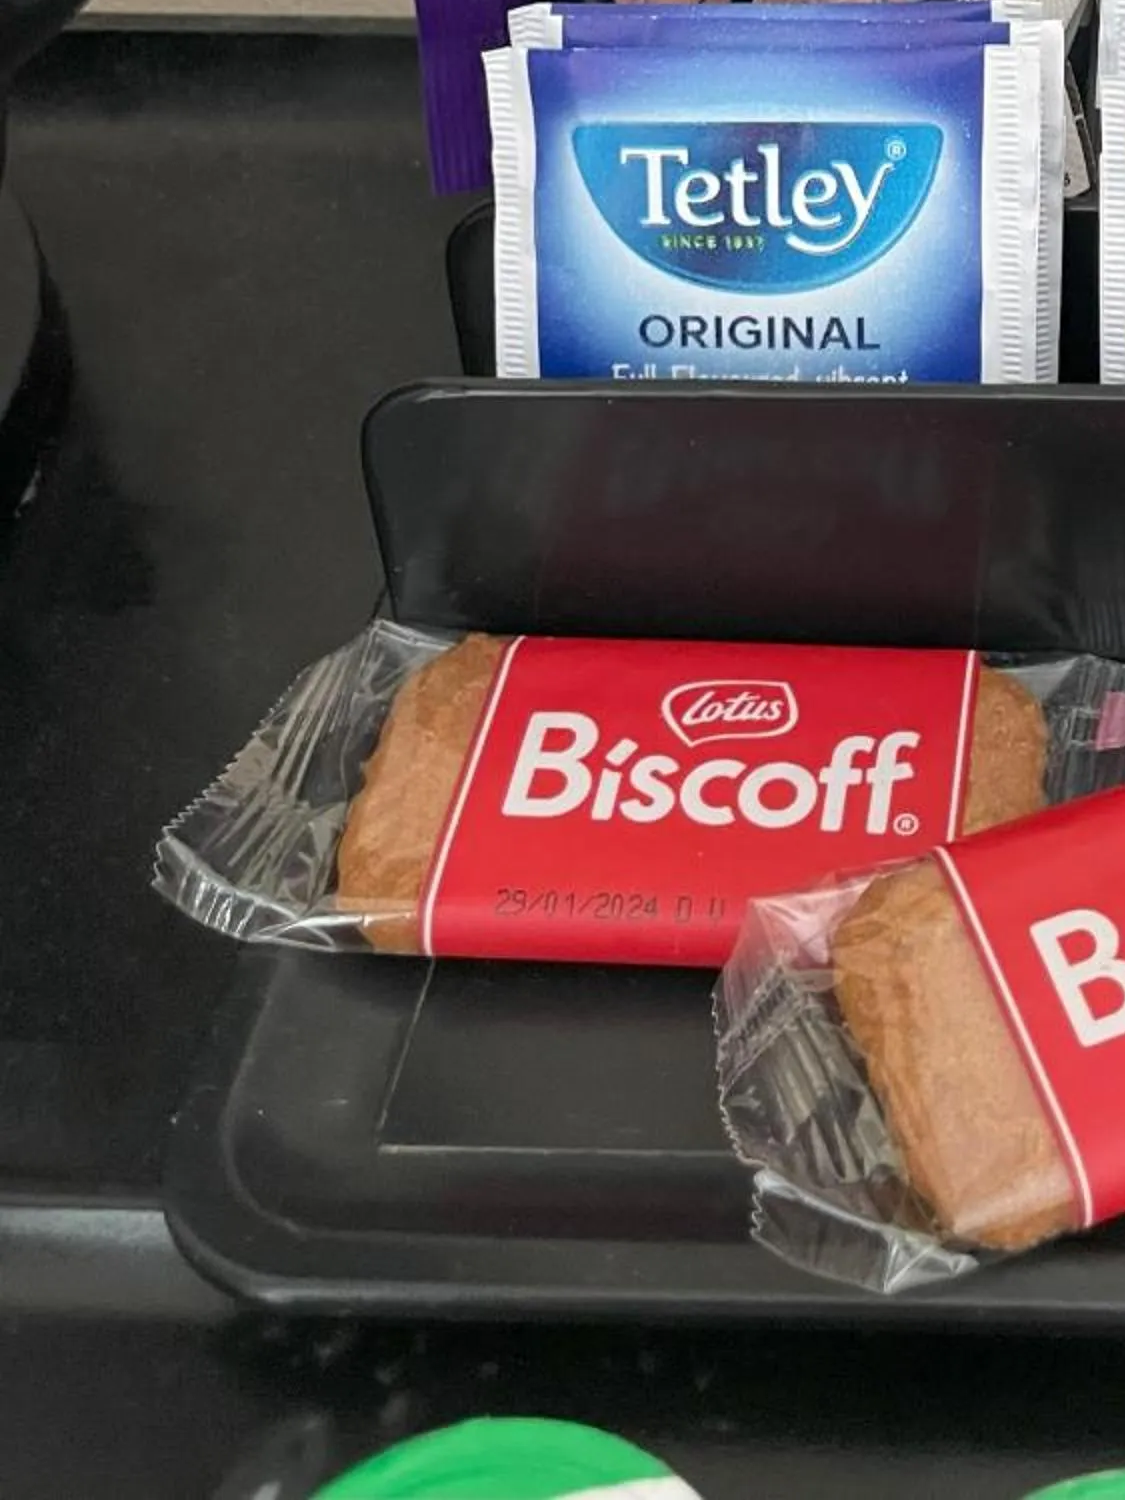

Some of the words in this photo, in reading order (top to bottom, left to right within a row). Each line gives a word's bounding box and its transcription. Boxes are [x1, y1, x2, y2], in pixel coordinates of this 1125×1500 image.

[661, 235, 717, 251] SINCE
[638, 314, 881, 351] ORIGINAL
[502, 711, 921, 836] Biscoff
[494, 887, 659, 920] 29/01/2024
